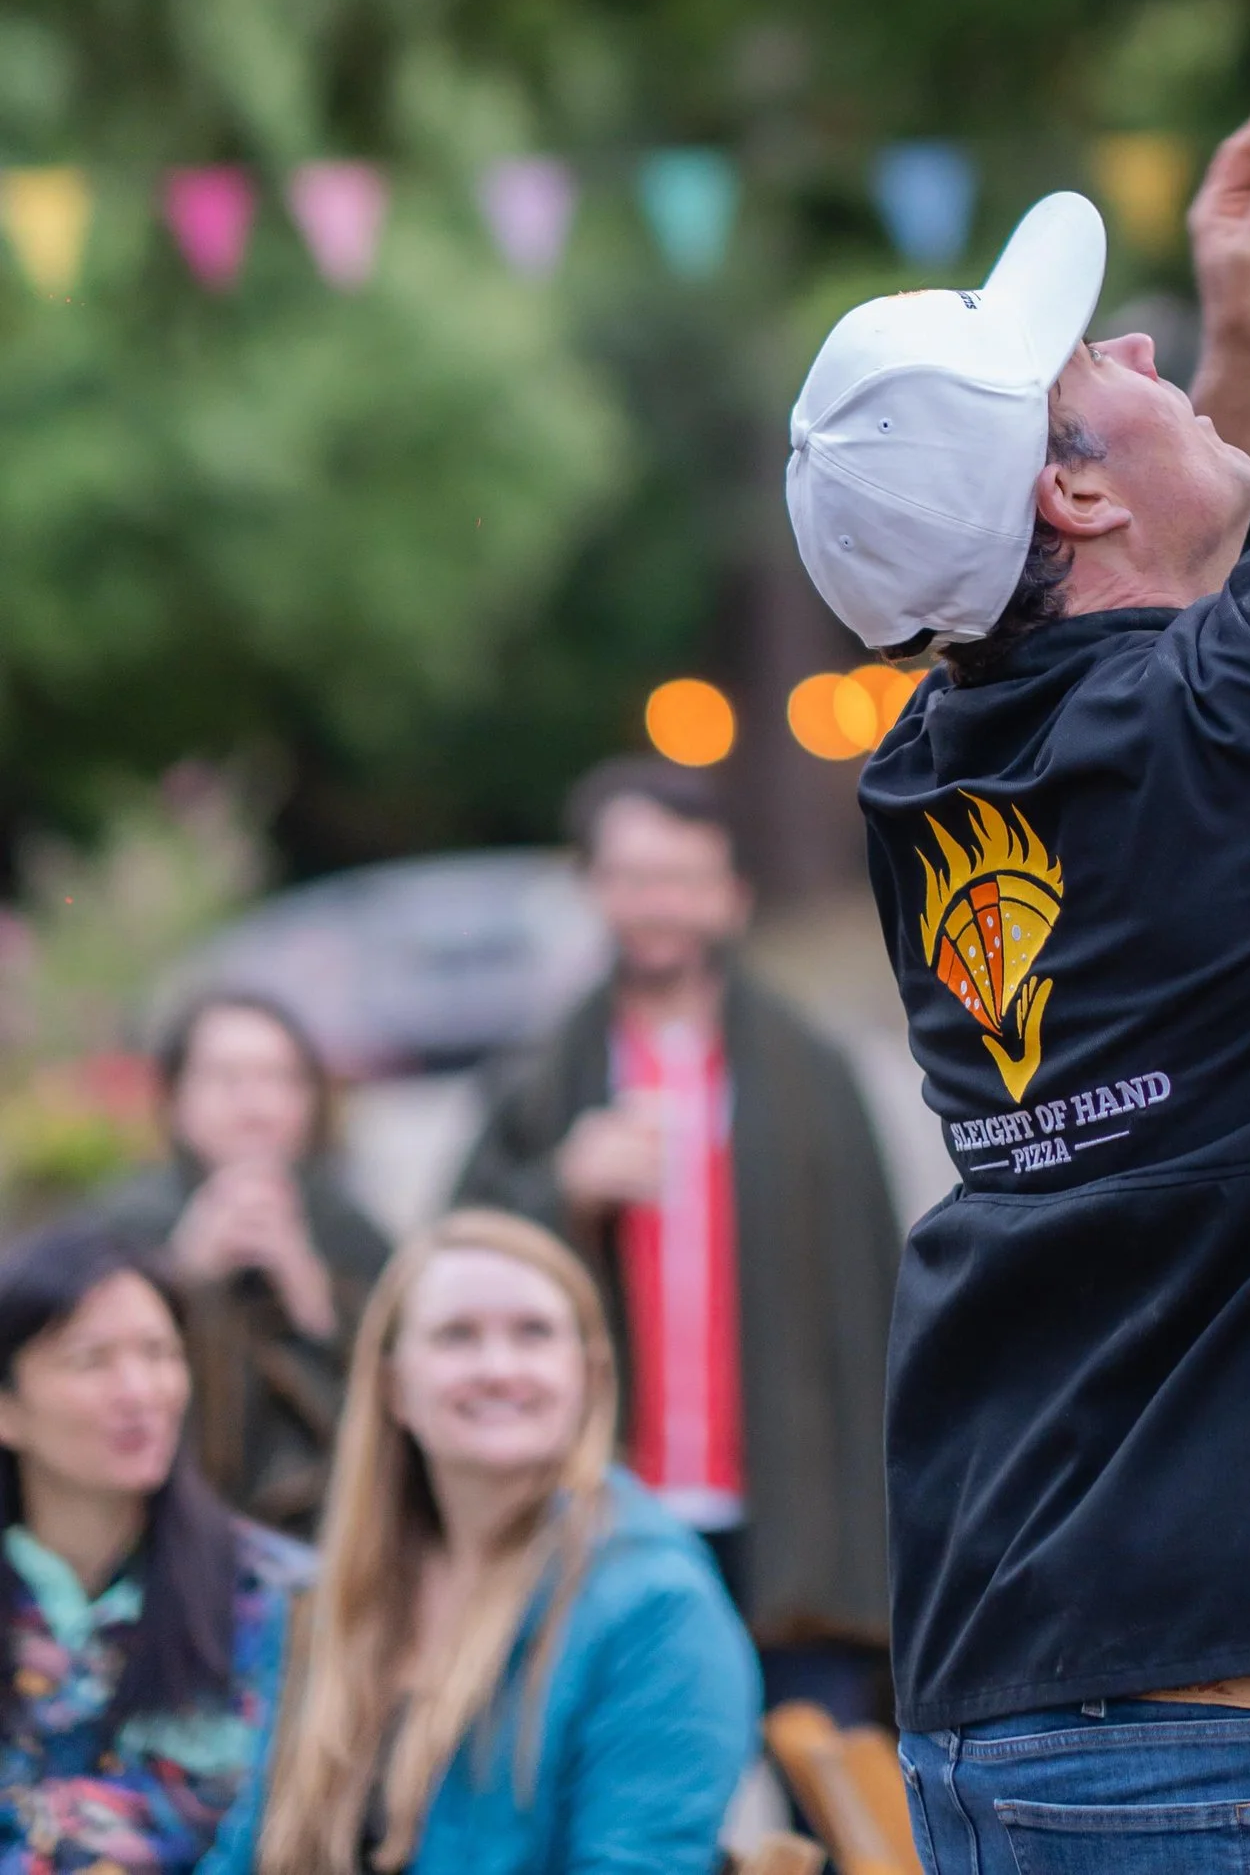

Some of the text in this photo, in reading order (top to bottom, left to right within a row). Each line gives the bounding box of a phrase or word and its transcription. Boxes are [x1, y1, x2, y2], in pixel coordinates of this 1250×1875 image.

[950, 1071, 1171, 1152] SLEIGHT OF HAND
[1011, 1137, 1072, 1174] PIZZA
